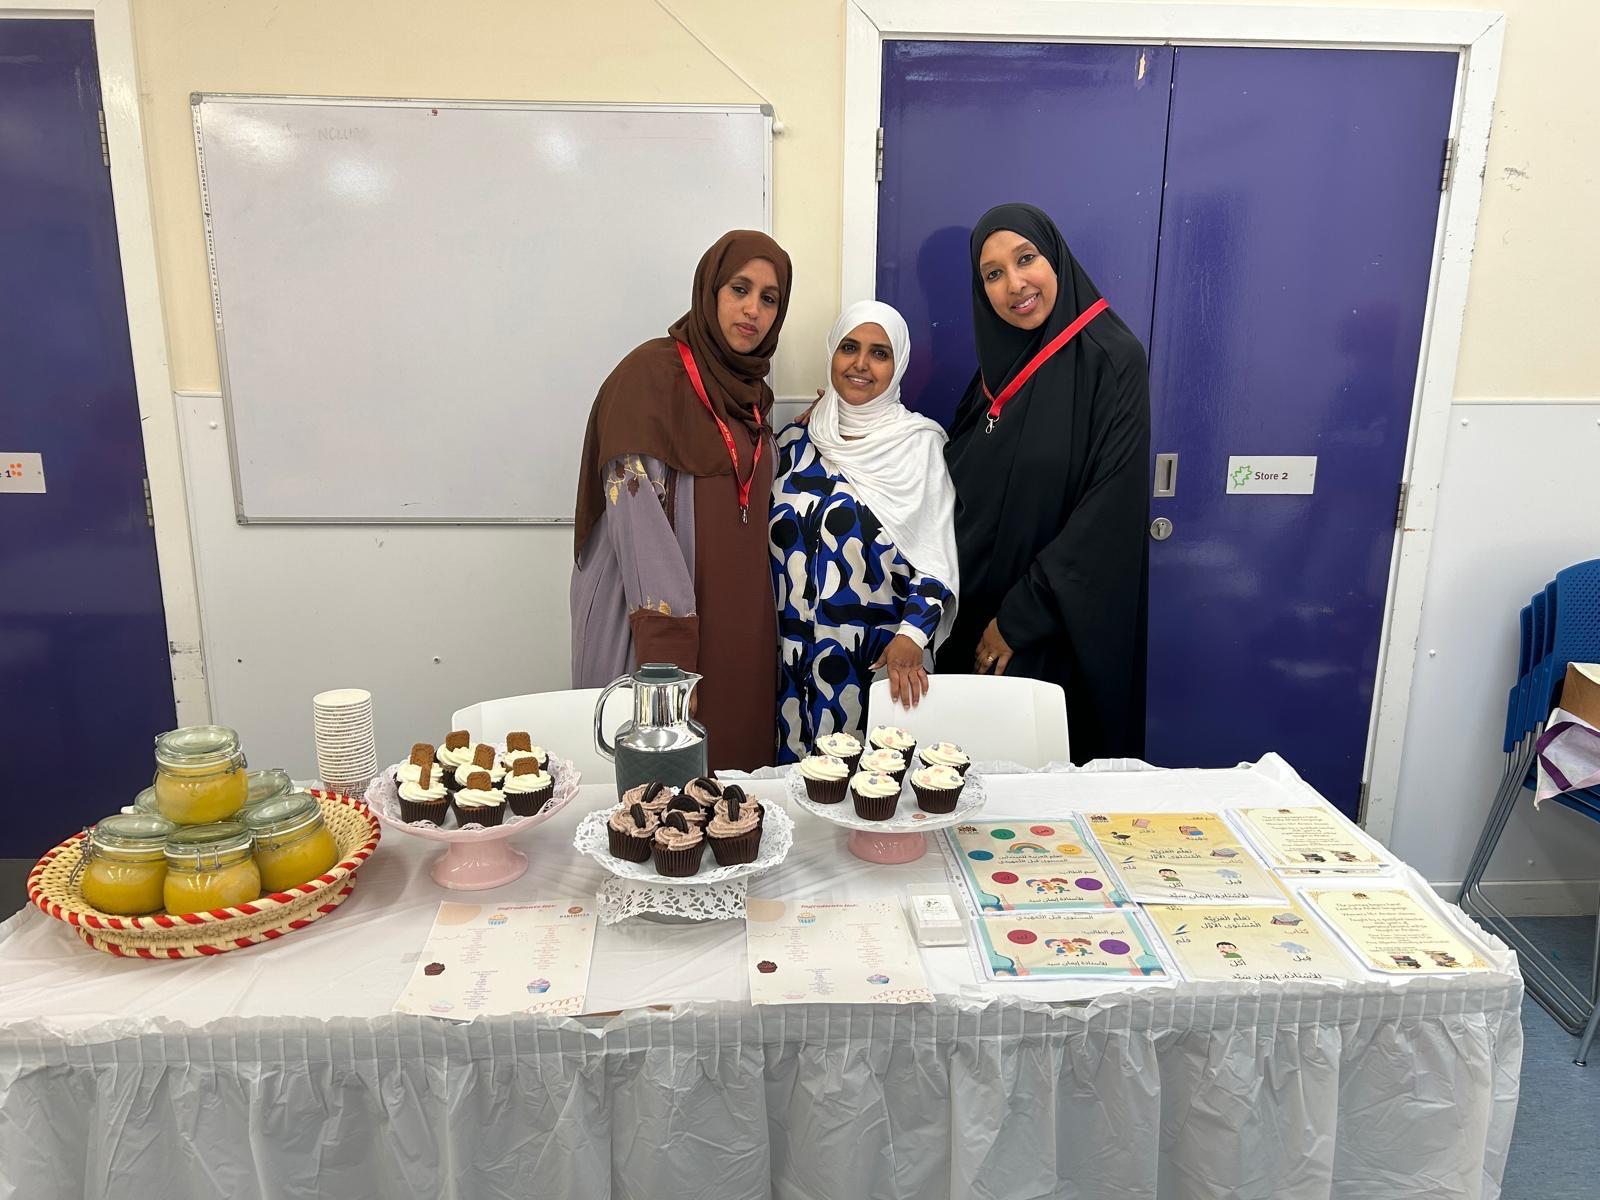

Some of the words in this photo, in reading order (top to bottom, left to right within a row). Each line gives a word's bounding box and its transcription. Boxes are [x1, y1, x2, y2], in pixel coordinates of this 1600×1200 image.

[198, 147, 207, 192] WHITEBOARD
[5, 470, 11, 478] 1
[1254, 471, 1279, 480] Store
[1281, 472, 1289, 480] 2
